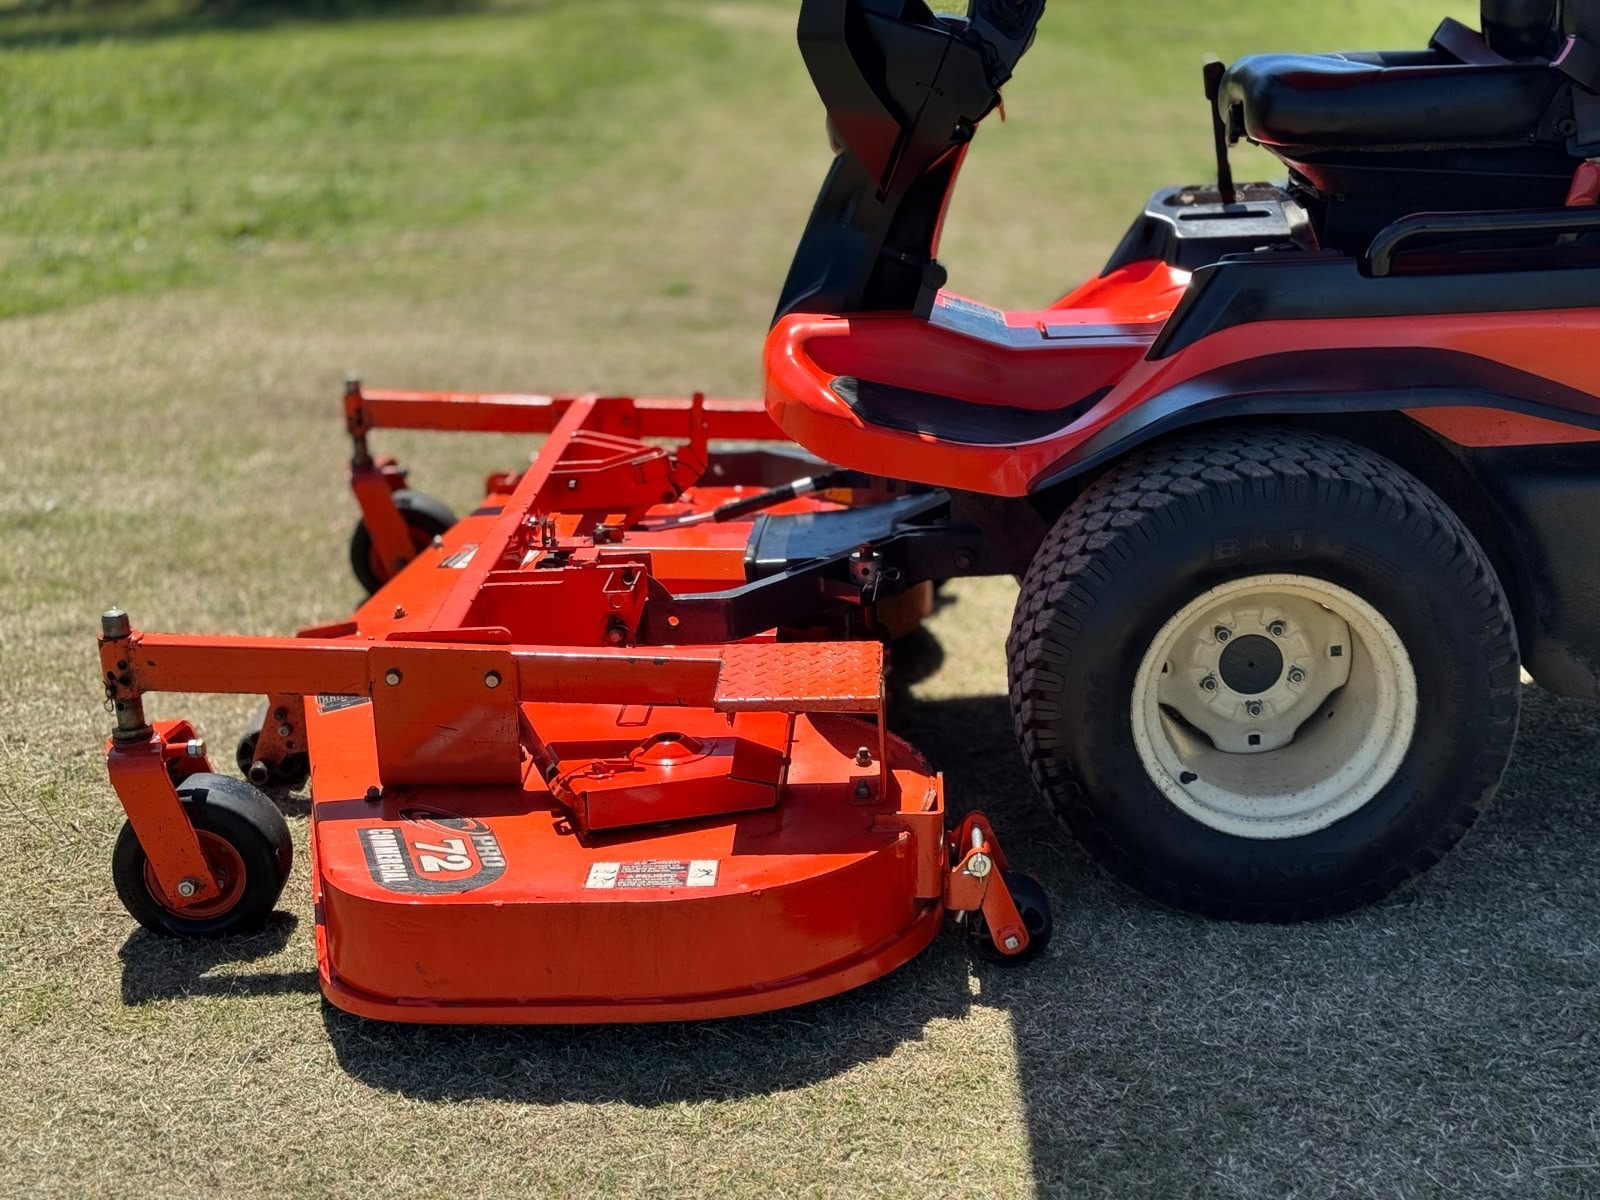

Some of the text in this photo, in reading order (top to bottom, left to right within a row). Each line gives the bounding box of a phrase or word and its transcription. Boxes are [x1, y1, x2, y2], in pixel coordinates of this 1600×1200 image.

[367, 828, 410, 884] COMMERCIAL
[413, 838, 473, 872] 72
[472, 835, 506, 867] PRO
